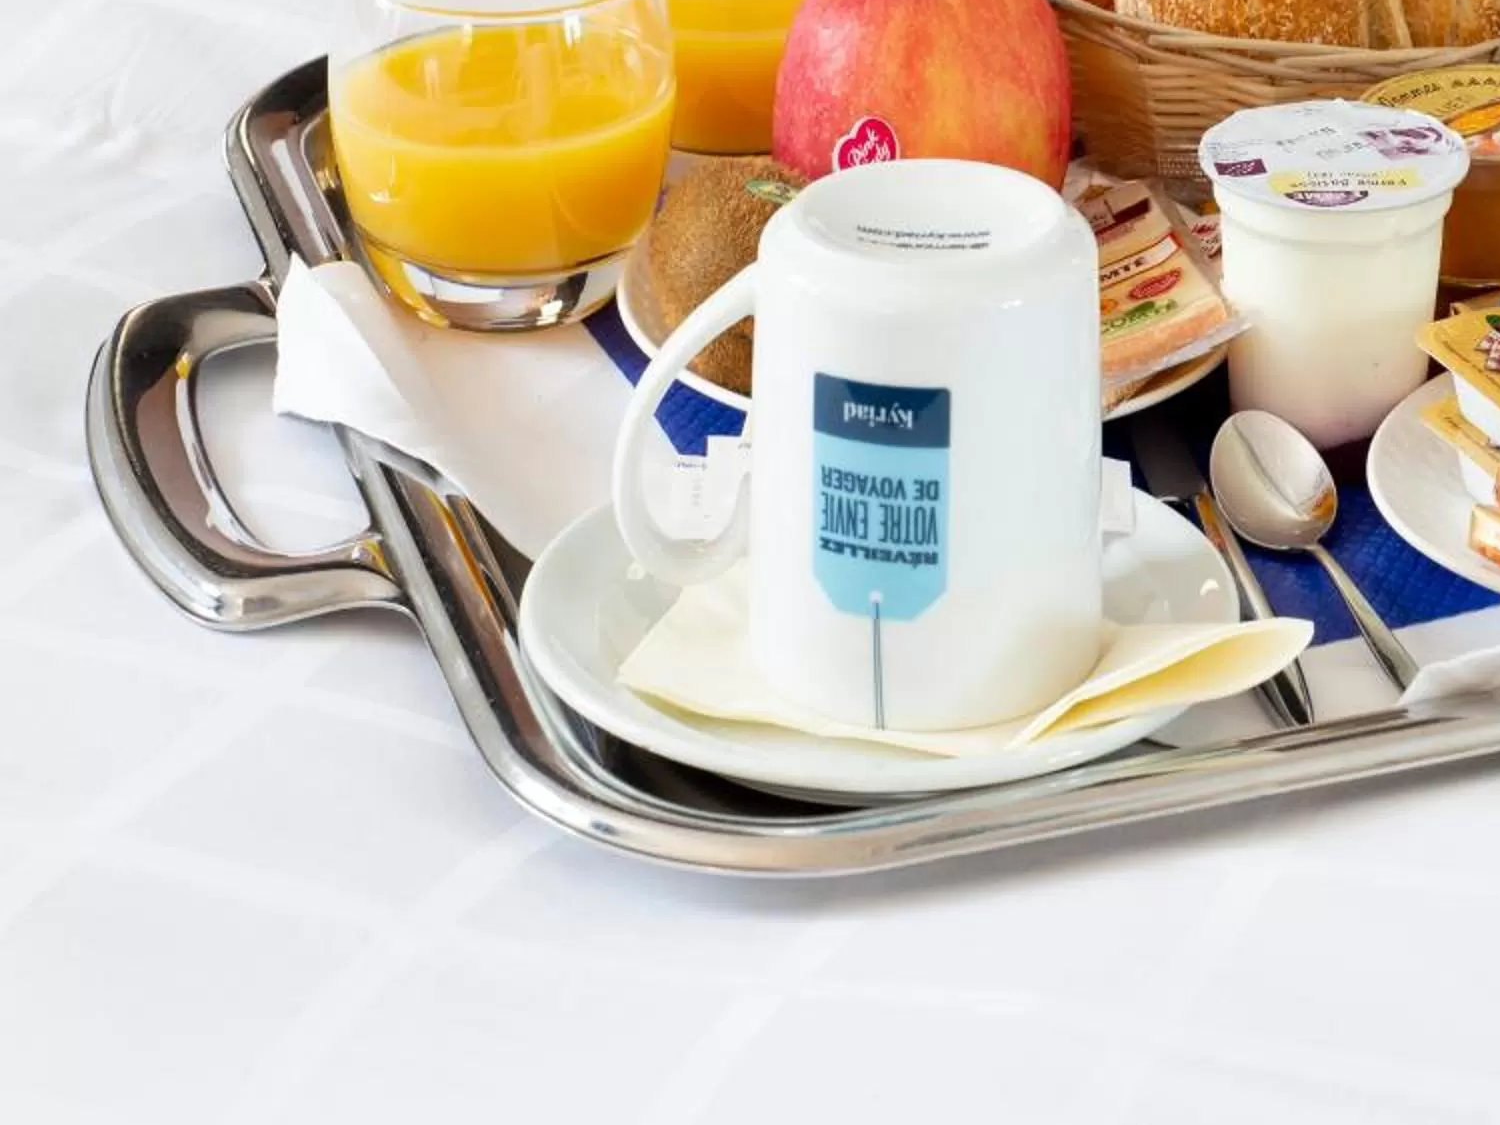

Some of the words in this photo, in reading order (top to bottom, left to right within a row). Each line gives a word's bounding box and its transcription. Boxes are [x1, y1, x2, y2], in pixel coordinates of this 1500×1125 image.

[842, 396, 914, 431] Kyriad
[820, 464, 907, 498] VOYAGER
[913, 478, 940, 502] DE
[820, 491, 869, 540] ENVIE
[878, 501, 938, 545] VOTRE
[819, 536, 939, 570] RÉVEILLEZ
